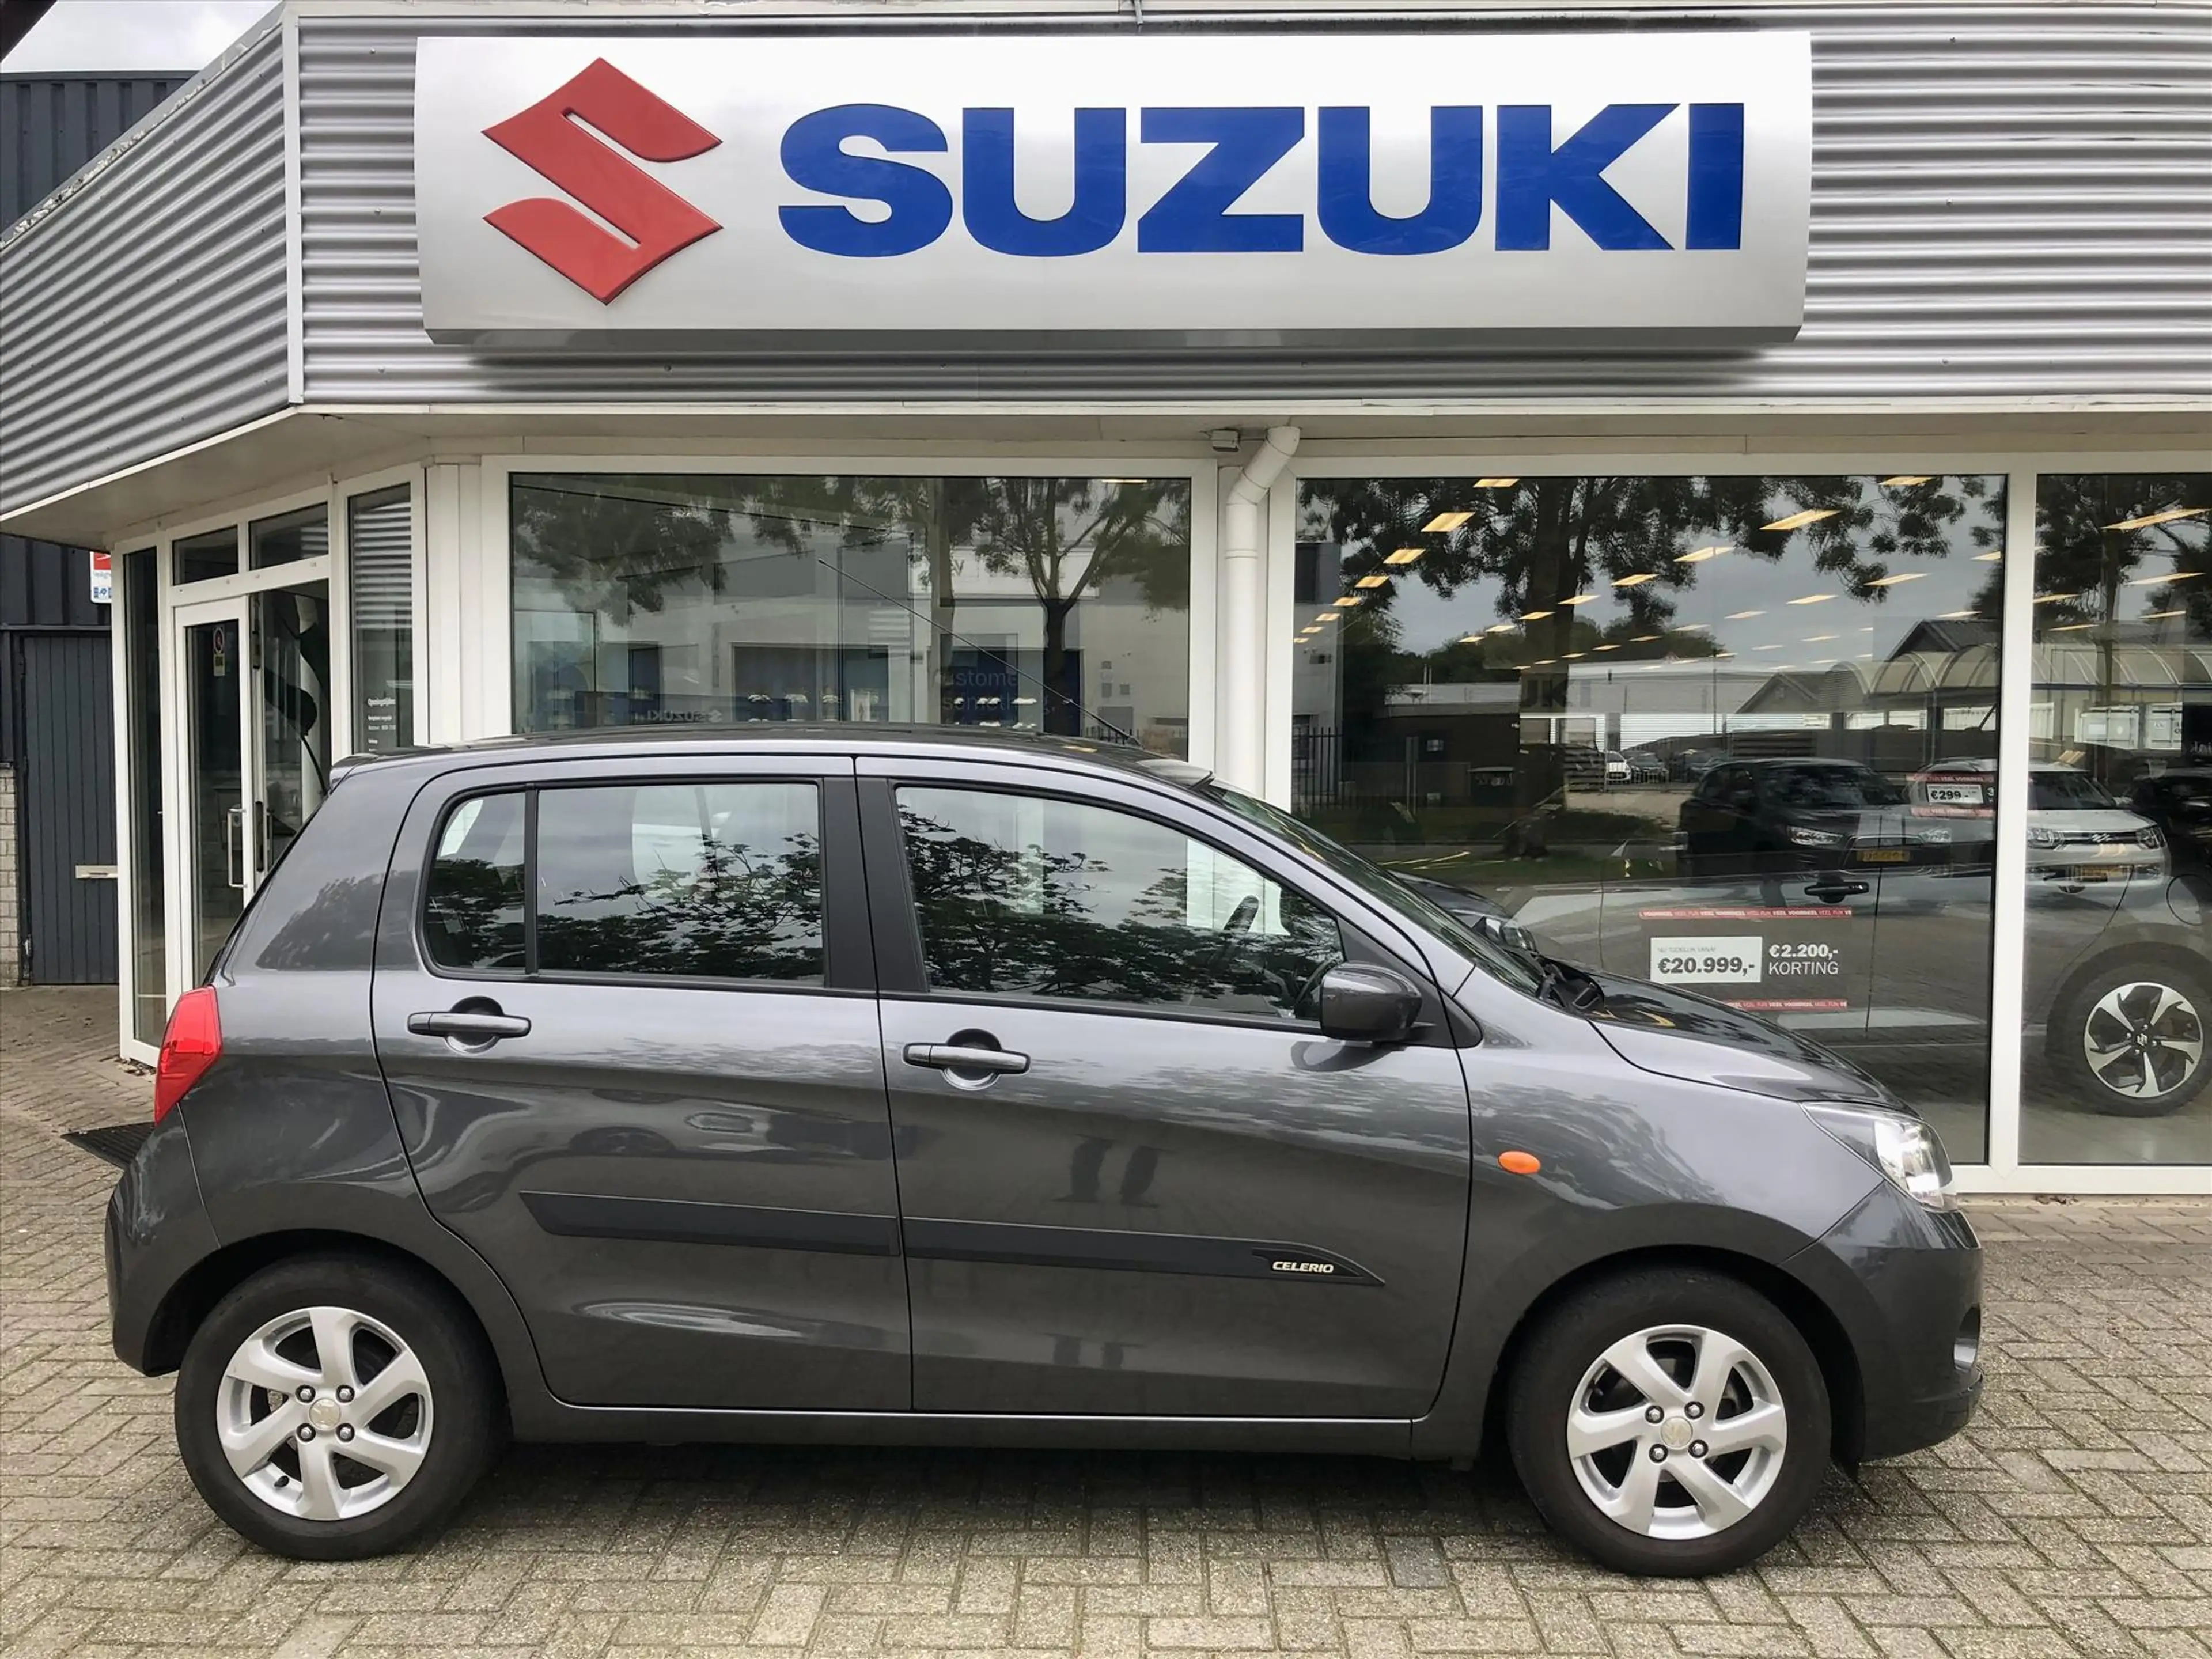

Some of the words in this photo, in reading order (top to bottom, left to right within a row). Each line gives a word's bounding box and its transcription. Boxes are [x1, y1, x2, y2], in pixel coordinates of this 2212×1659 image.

[778, 102, 1744, 257] SUZUKI
[1930, 790, 1969, 800] €299-
[1769, 944, 1839, 960] €2.200,-
[1657, 956, 1755, 976] €20.999,-
[1769, 961, 1839, 975] KORTING
[1272, 1260, 1335, 1274] CELERIO
